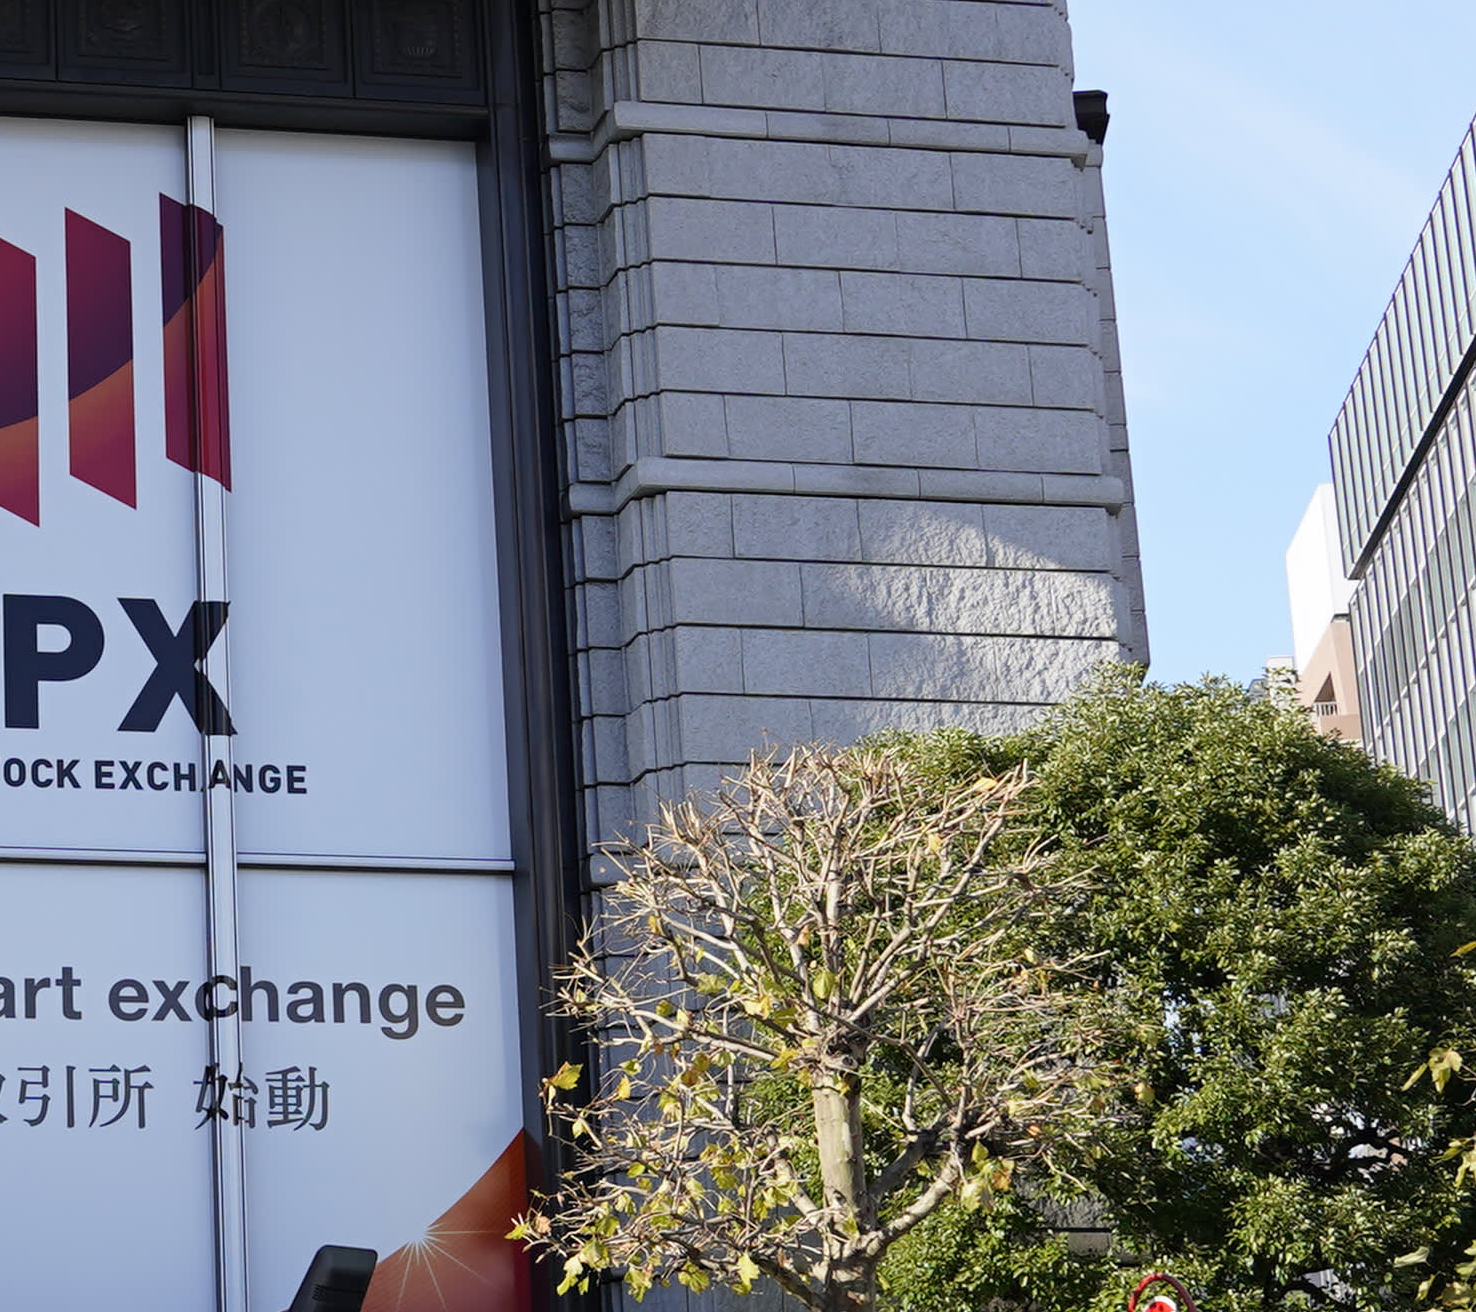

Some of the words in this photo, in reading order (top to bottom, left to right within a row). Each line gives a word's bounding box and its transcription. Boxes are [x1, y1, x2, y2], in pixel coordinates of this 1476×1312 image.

[94, 759, 308, 794] EXCHANGE
[107, 965, 467, 1040] exchange
[192, 1062, 331, 1132] 始動
